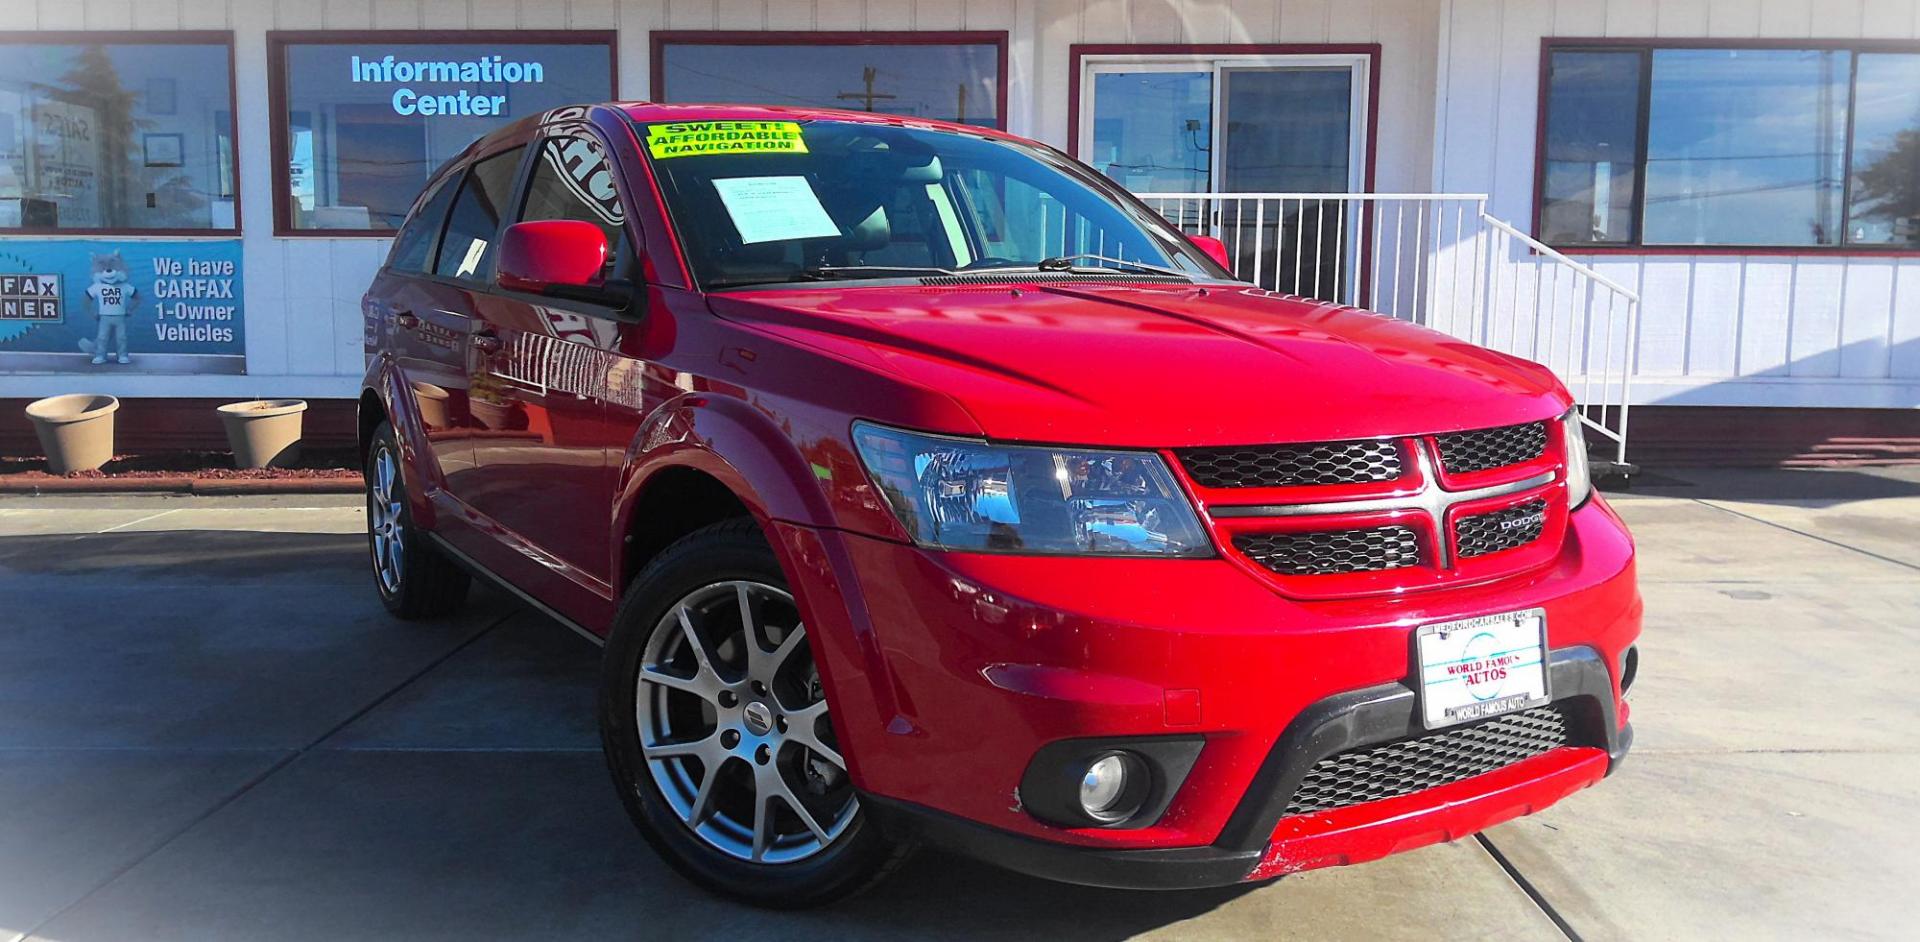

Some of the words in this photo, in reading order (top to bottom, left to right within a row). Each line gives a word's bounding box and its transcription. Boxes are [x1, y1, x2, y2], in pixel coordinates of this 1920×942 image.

[352, 55, 543, 83] Information
[392, 89, 506, 116] Center
[653, 132, 797, 146] AFFORDABLE
[664, 141, 791, 154] NAVIGATION
[153, 258, 183, 276] We
[188, 258, 234, 276] have
[101, 288, 122, 297] CAR
[154, 279, 233, 299] CARFAX
[103, 297, 121, 306] FOX
[155, 303, 235, 322] 1-Owner
[155, 323, 233, 343] Vehicles
[1447, 661, 1482, 675] WORLD
[1466, 667, 1507, 686] AUTOS
[1456, 705, 1480, 721] WORLD
[1481, 699, 1507, 716] FAMOUS
[1508, 696, 1525, 710] AUTO
